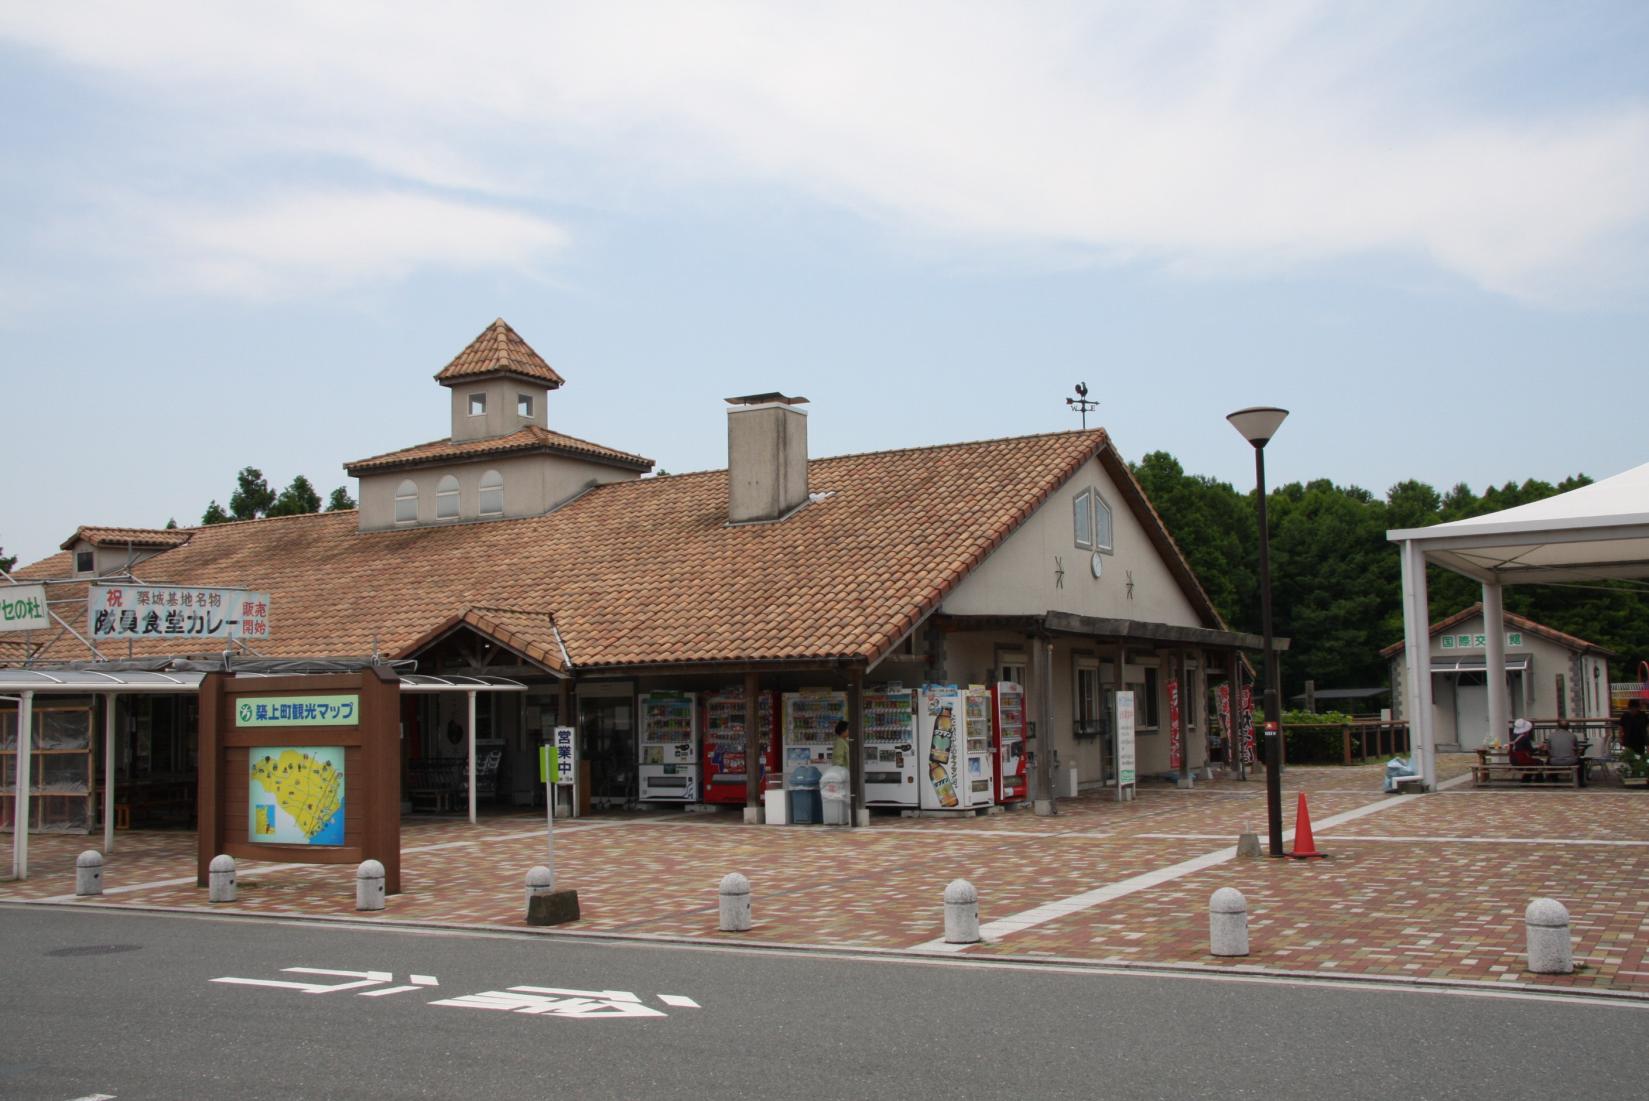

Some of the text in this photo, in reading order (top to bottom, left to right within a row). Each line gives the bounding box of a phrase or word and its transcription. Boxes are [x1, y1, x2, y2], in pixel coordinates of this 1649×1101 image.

[106, 588, 222, 608] 祝 築城基地名物
[242, 601, 267, 618] 販売
[94, 608, 239, 636] 隊員食堂カレー
[242, 619, 267, 635] 開始
[1442, 633, 1521, 648] 国際交館
[255, 702, 354, 721] 築上町観光マップ
[557, 730, 572, 775] 営業中
